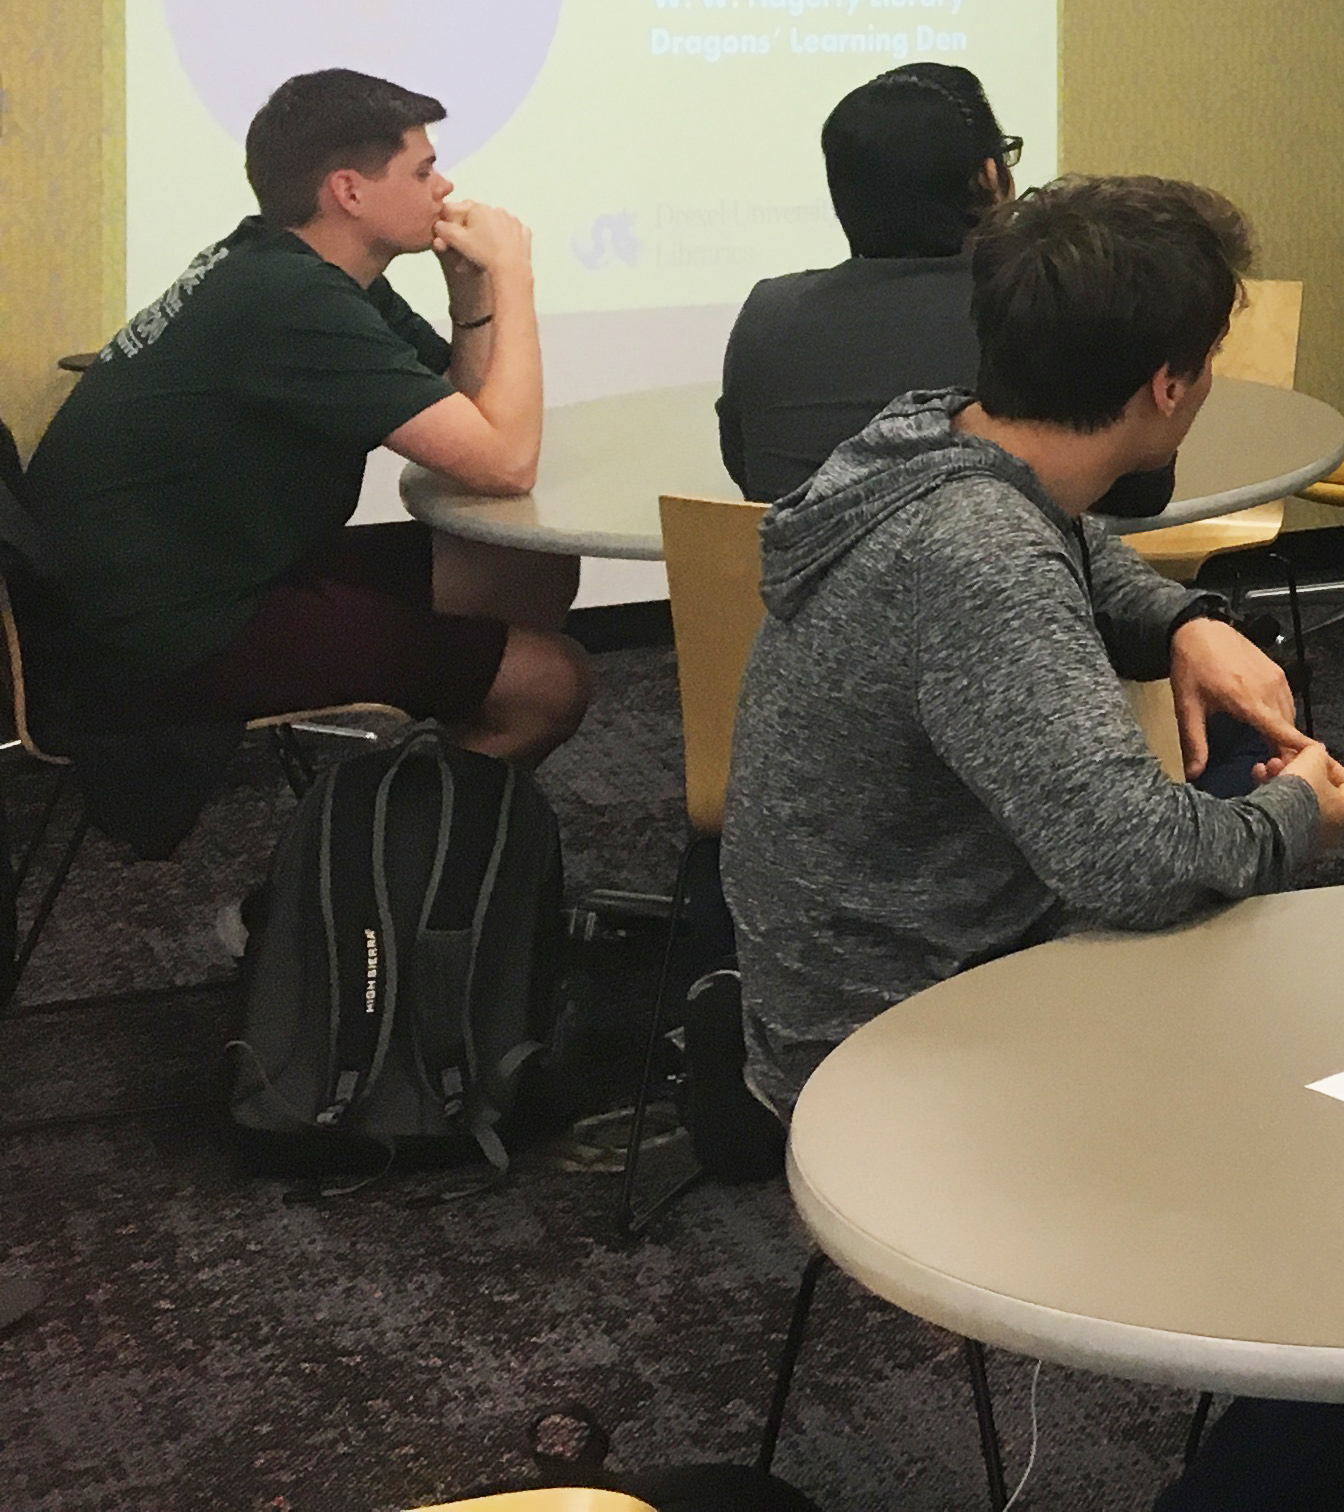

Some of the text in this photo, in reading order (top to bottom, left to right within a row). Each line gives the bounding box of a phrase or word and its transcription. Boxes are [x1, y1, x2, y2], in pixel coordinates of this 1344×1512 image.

[789, 23, 909, 60] Learning
[915, 23, 968, 53] Den
[655, 199, 726, 229] Drexel
[655, 240, 755, 267] Libraries
[365, 929, 378, 1013] HIGH SIERRA
